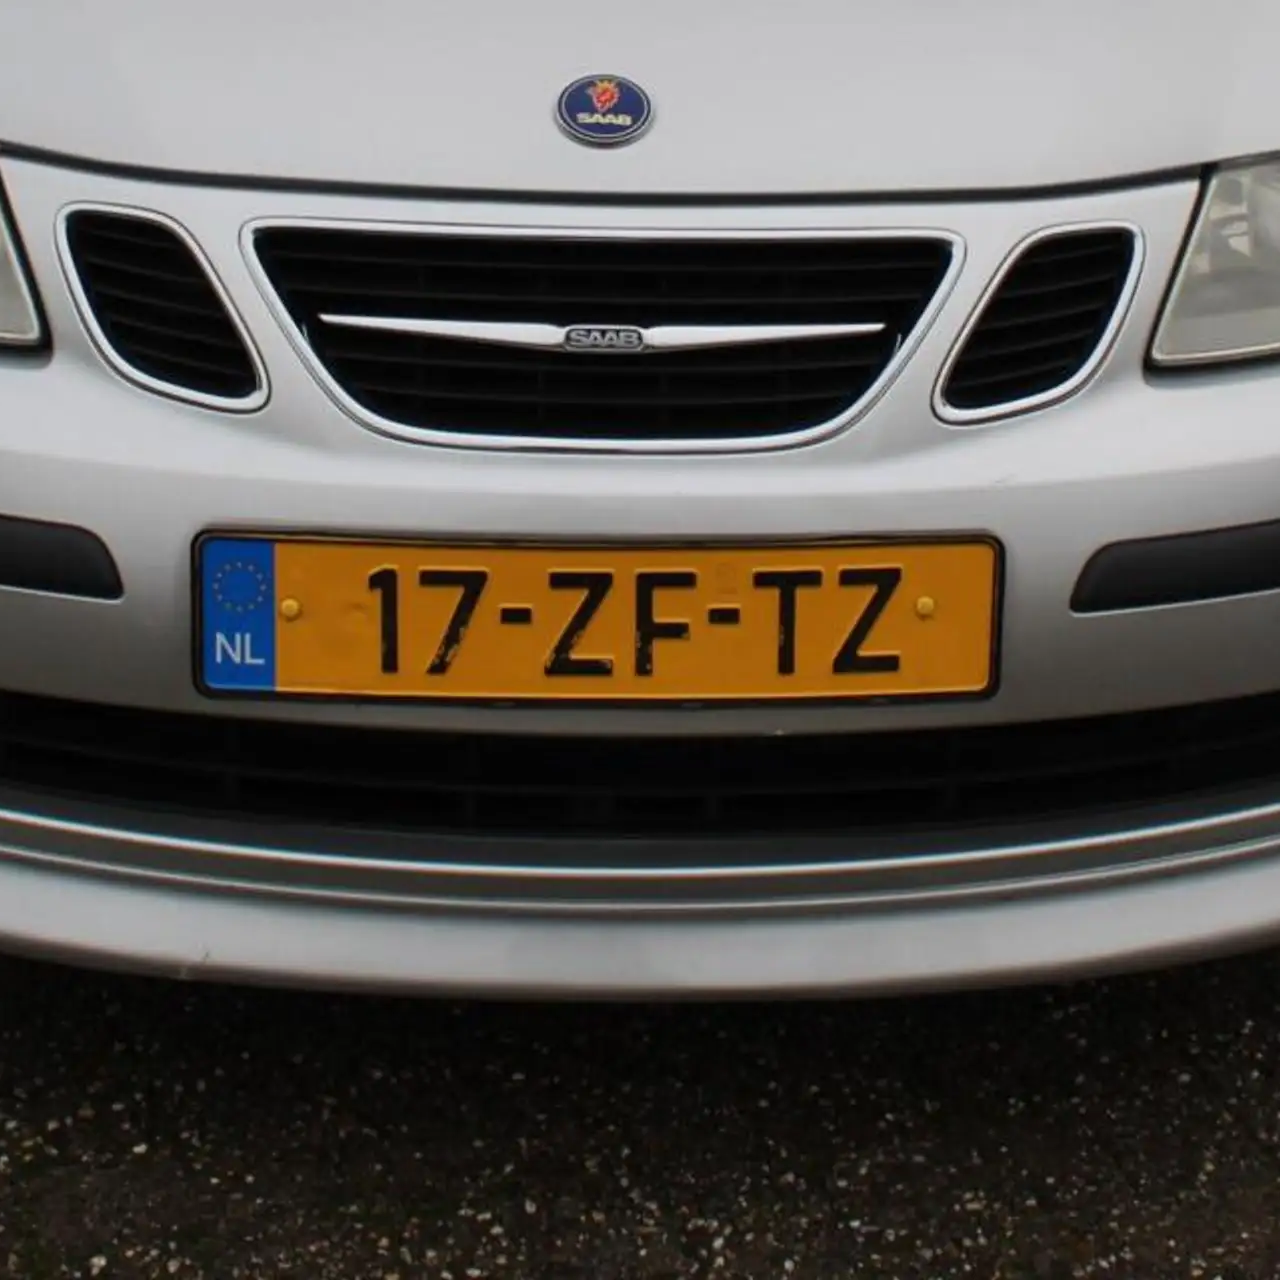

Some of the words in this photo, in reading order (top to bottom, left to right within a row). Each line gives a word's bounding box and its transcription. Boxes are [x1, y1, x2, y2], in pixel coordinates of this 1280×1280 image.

[575, 111, 633, 126] SAAB
[568, 328, 641, 349] SAAB
[214, 631, 265, 666] NL
[367, 563, 903, 678] 17-ZF-TZ
